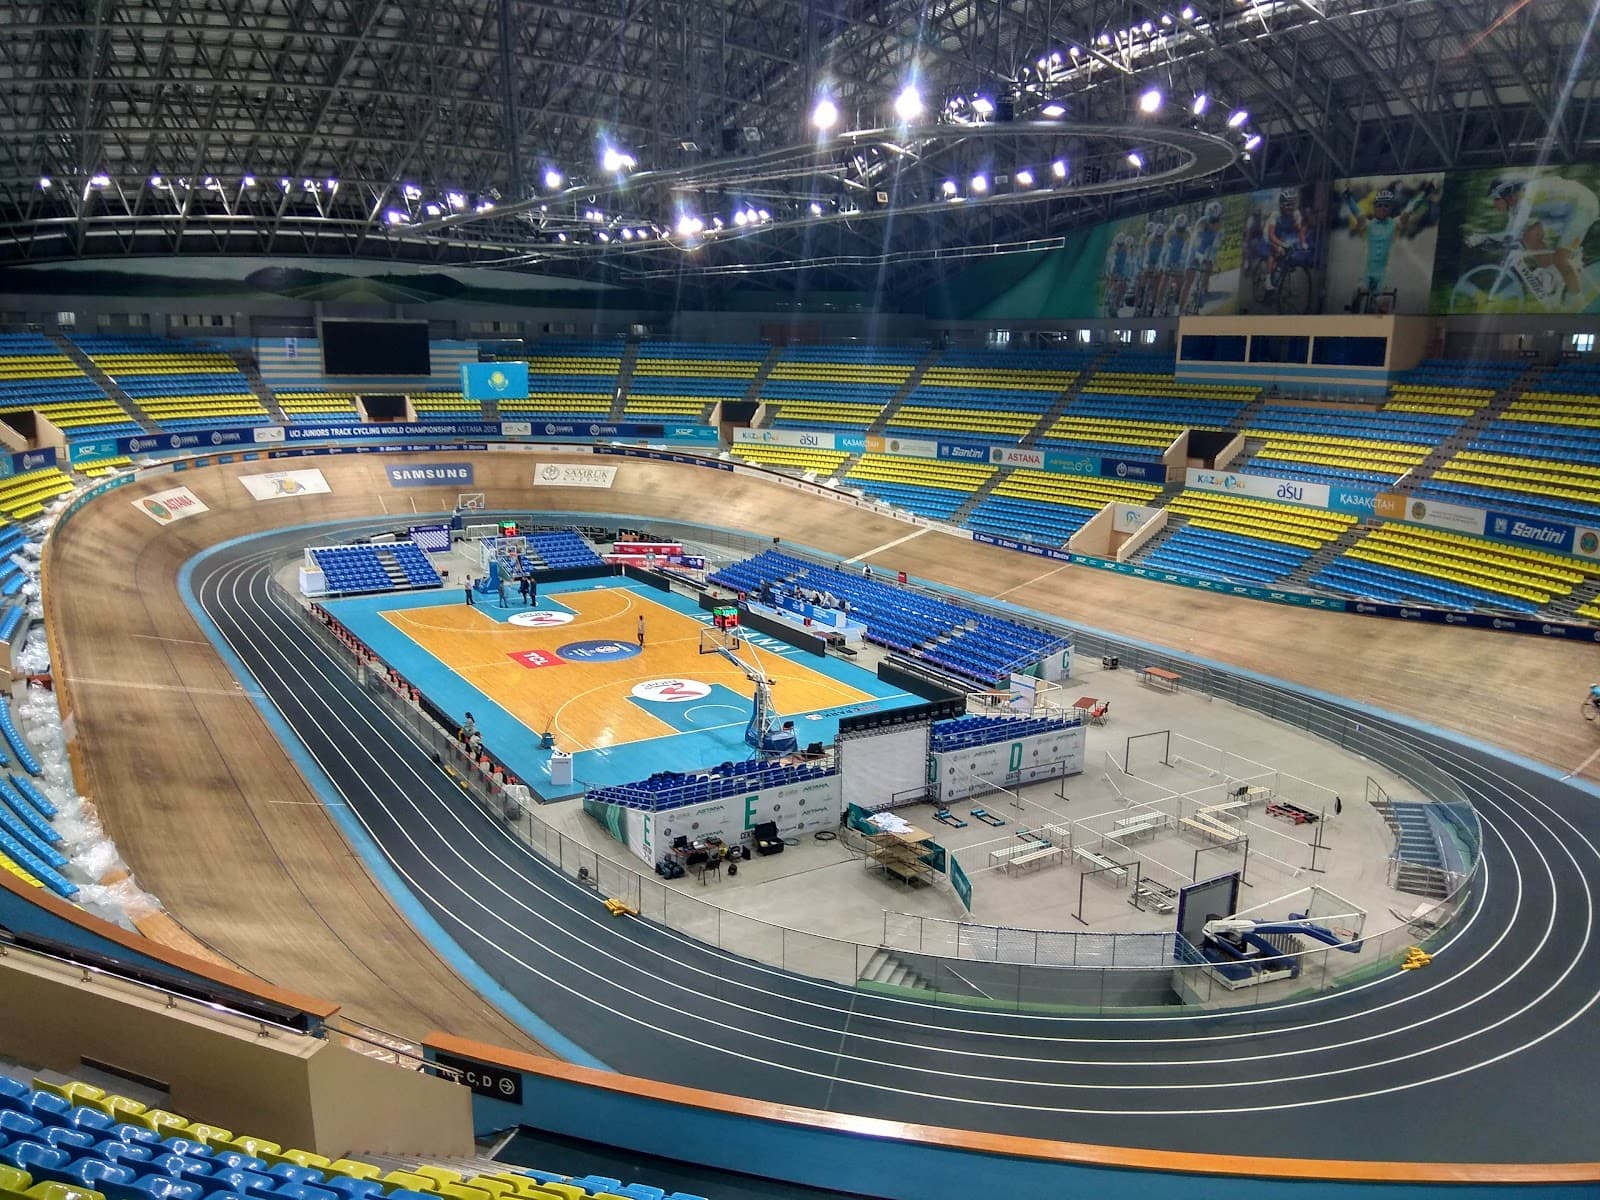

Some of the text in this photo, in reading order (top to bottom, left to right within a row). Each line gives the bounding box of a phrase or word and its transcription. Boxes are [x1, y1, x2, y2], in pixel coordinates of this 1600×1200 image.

[289, 430, 300, 438] UCI
[302, 428, 329, 437] JUNIORS
[330, 427, 352, 436] TRACK
[353, 426, 380, 435] CYCLING
[381, 426, 404, 434] WORLD
[405, 425, 456, 434] CHAMPIONSHIPS
[457, 425, 482, 433] ASTANA
[952, 446, 984, 459] Santini
[1007, 452, 1040, 464] ASTANA
[392, 468, 468, 480] SAMSUNG
[564, 467, 608, 479] SAMRUK
[163, 494, 196, 511] ASTANA
[1511, 521, 1567, 544] Santini
[725, 615, 737, 626] 24
[523, 651, 549, 666] TCL
[1063, 651, 1070, 669] C
[1009, 742, 1023, 772] D
[744, 795, 759, 830] E
[644, 814, 651, 847] E
